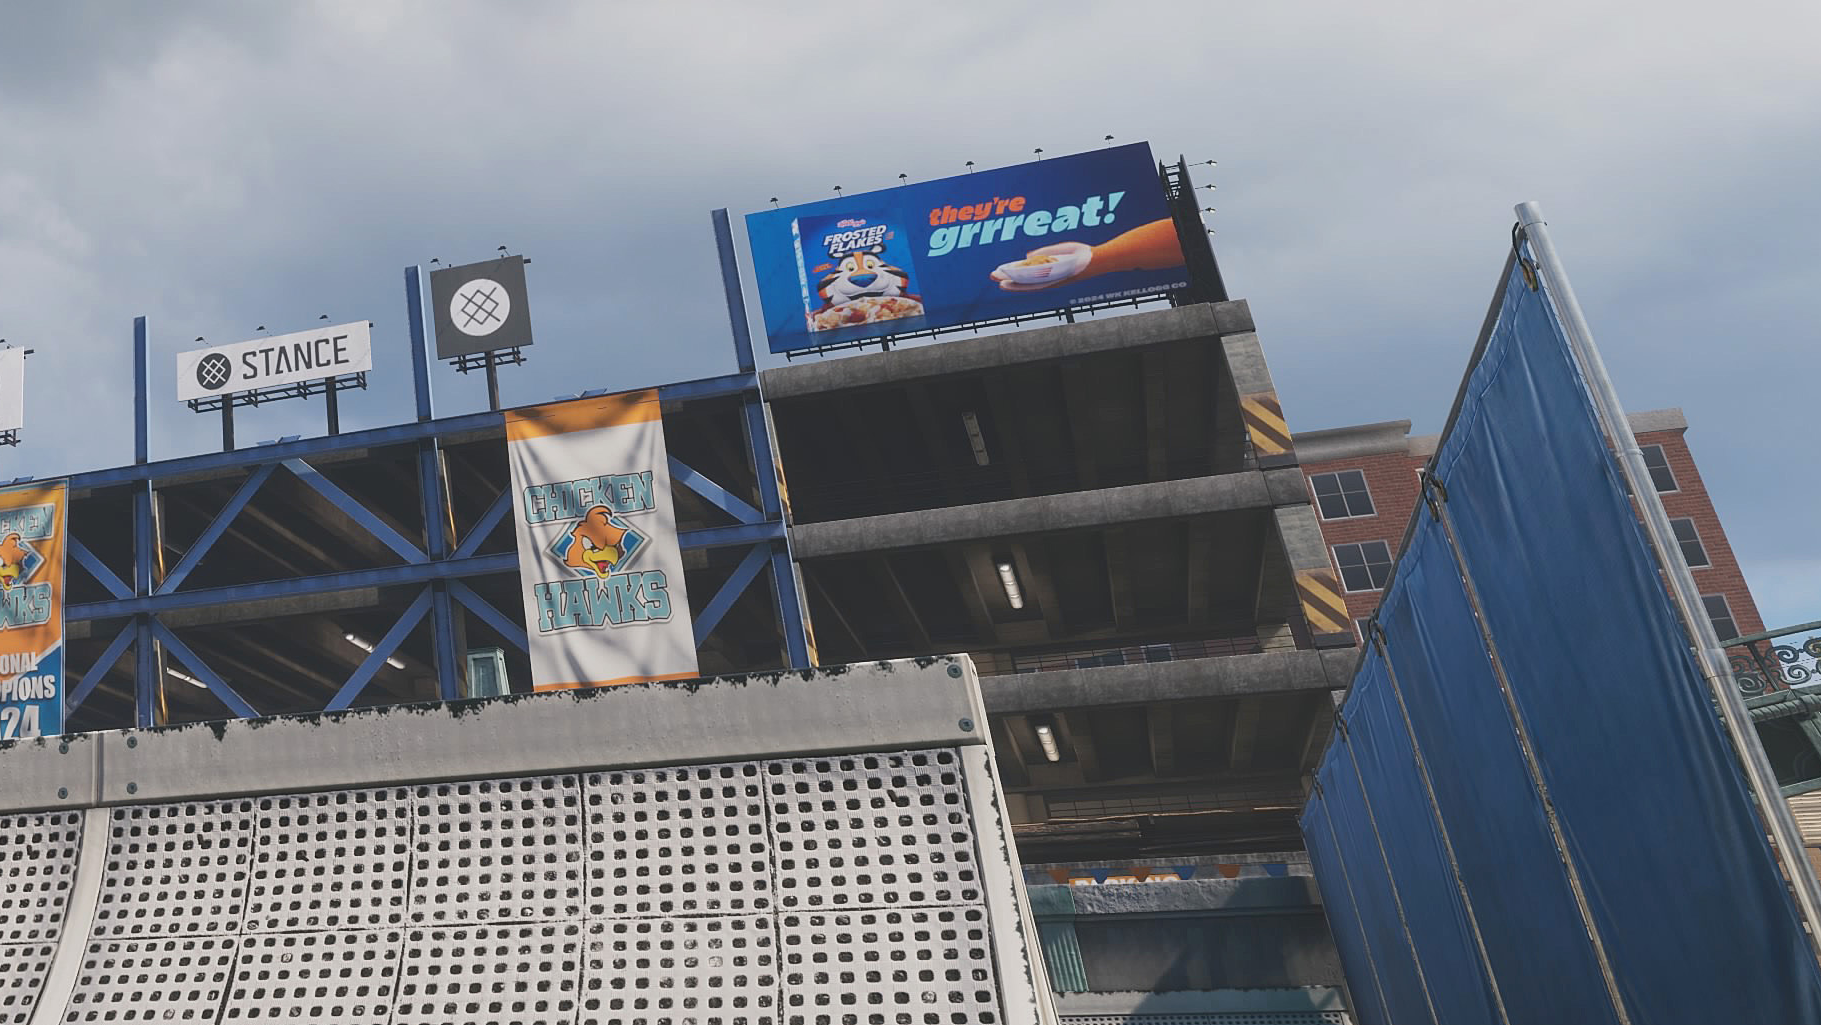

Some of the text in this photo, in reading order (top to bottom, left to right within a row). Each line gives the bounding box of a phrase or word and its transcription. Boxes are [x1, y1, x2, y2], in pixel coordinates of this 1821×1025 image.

[928, 191, 1126, 257] grrreat!
[929, 196, 1026, 226] they're
[823, 224, 887, 246] FROSTED
[828, 234, 883, 254] FLAKES
[1123, 284, 1170, 297] KELLOGG
[241, 334, 350, 380] STANCE
[523, 470, 655, 524] CHICKEN
[534, 570, 672, 633] HAWKS
